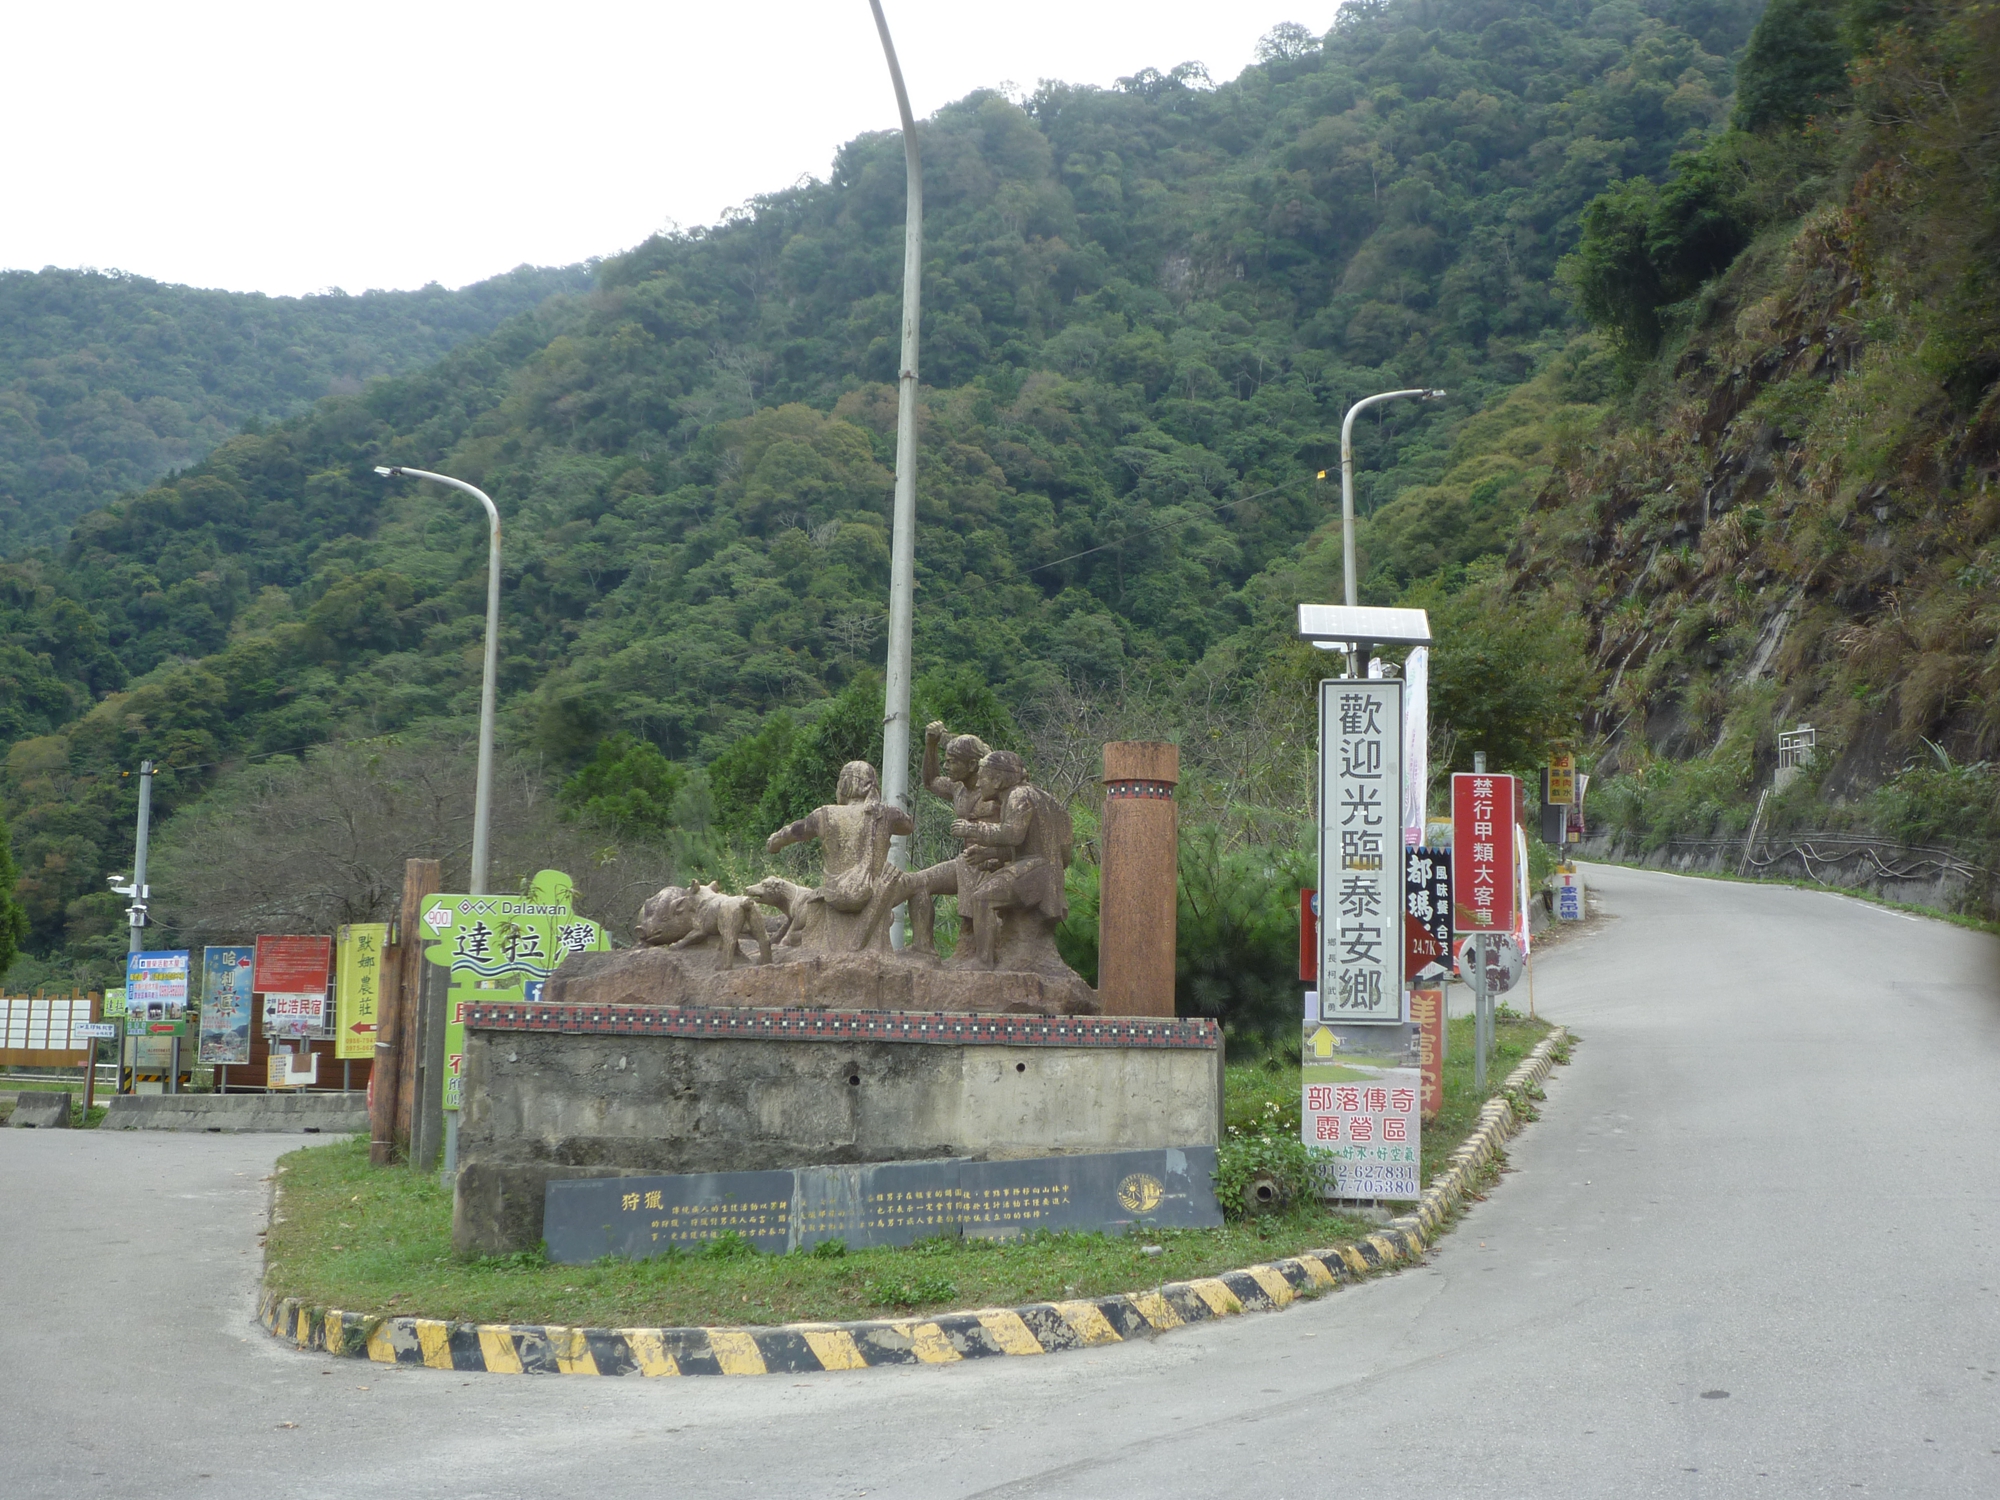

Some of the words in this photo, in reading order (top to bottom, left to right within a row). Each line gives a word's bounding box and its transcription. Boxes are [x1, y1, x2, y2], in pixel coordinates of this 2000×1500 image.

[1551, 779, 1572, 788] 烤肉
[1338, 693, 1383, 1012] 歡迎光臨泰安鄉
[1472, 777, 1494, 928] 禁行甲類大客車
[501, 901, 566, 916] Dalawan
[1406, 854, 1434, 937] 都瑪
[452, 921, 595, 963] 達拉灣
[1412, 938, 1437, 956] 24.7K
[1327, 937, 1337, 1012] 鄉長柯武勇
[276, 998, 322, 1015] 比浩民宿
[1308, 1086, 1415, 1113] 部落傳奇
[1316, 1115, 1406, 1142] 露營區
[1311, 1164, 1415, 1180] 912-627831
[621, 1190, 664, 1211] 狩獵
